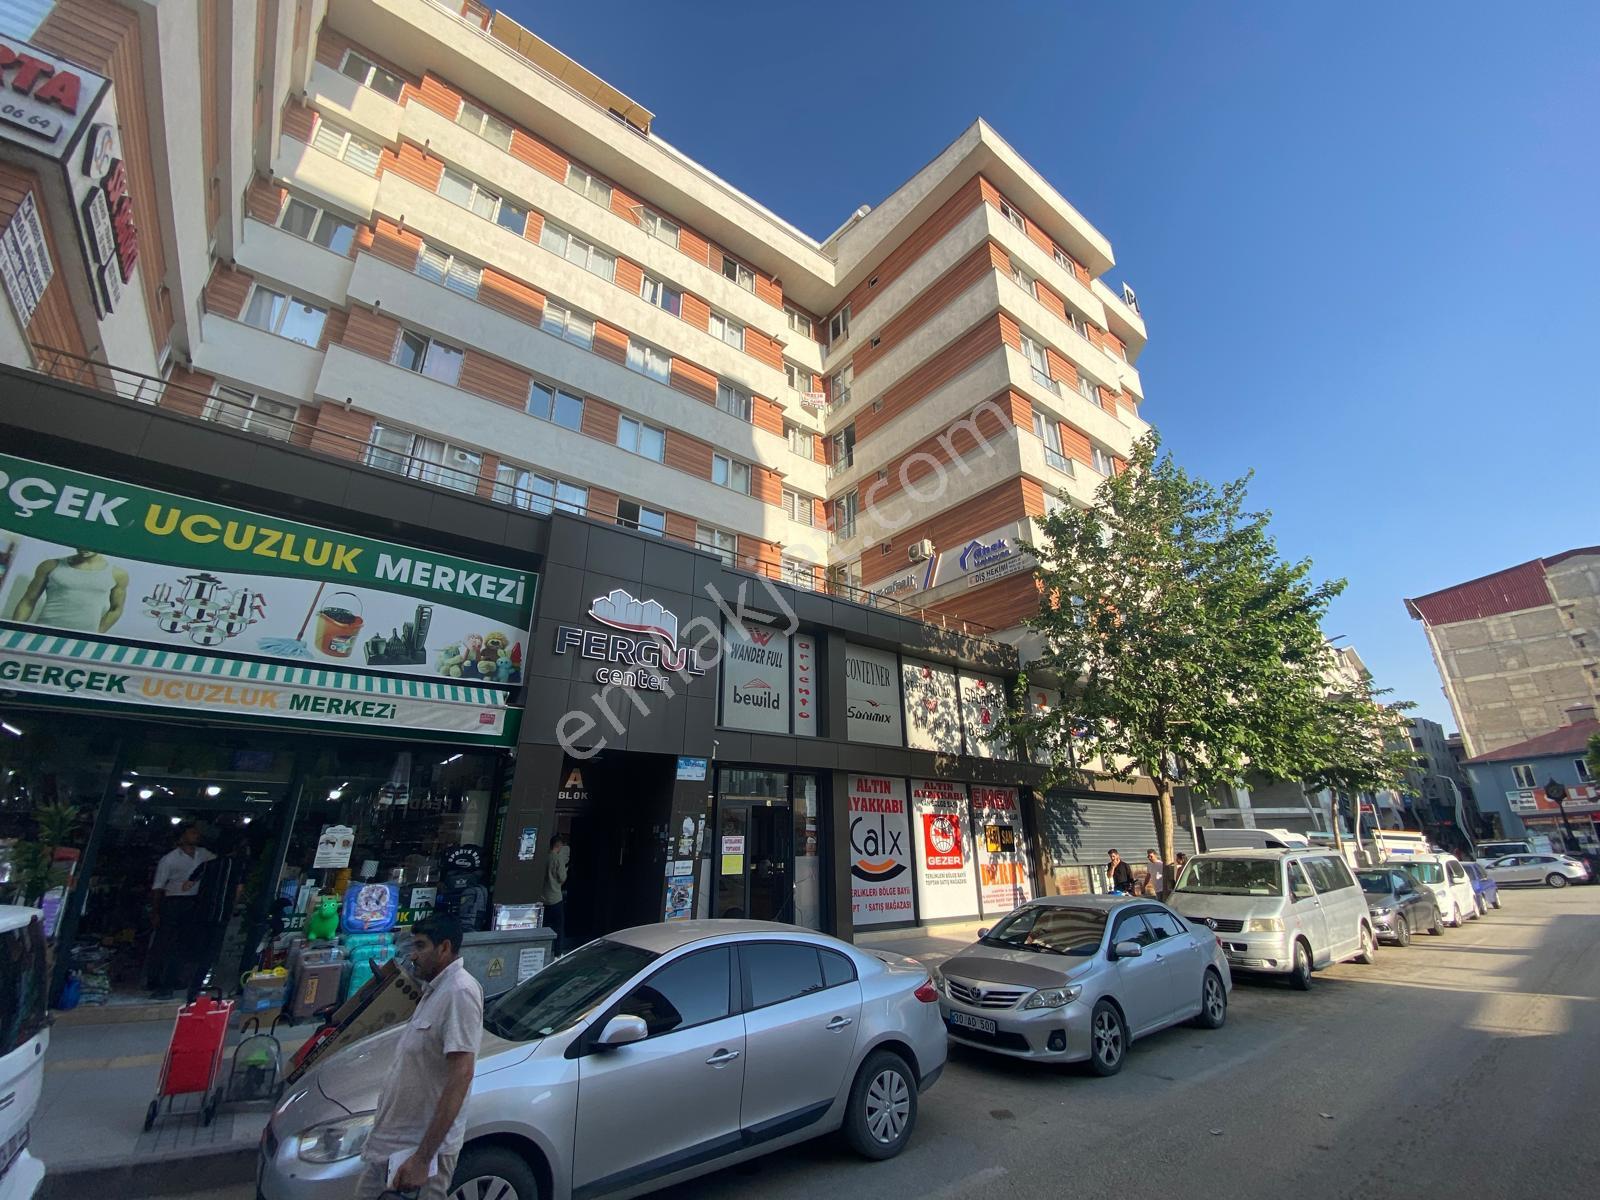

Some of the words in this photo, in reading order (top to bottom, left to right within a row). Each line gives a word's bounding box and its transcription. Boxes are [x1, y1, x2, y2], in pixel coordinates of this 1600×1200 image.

[27, 115, 50, 129] 64
[0, 470, 129, 527] ÇEK
[144, 503, 363, 574] UCUZLUK
[375, 553, 526, 605] MERKEZİ
[731, 641, 766, 665] WANDER
[766, 650, 783, 669] FULL
[0, 660, 130, 694] GERÇEK
[141, 677, 279, 710] UCUZLUK
[596, 668, 670, 691] center
[733, 685, 780, 710] bewild
[565, 768, 584, 788] A
[856, 778, 891, 794] ALTIN
[558, 791, 589, 800] BLOK
[972, 787, 1017, 811] EMEK
[928, 856, 962, 866] GEZER
